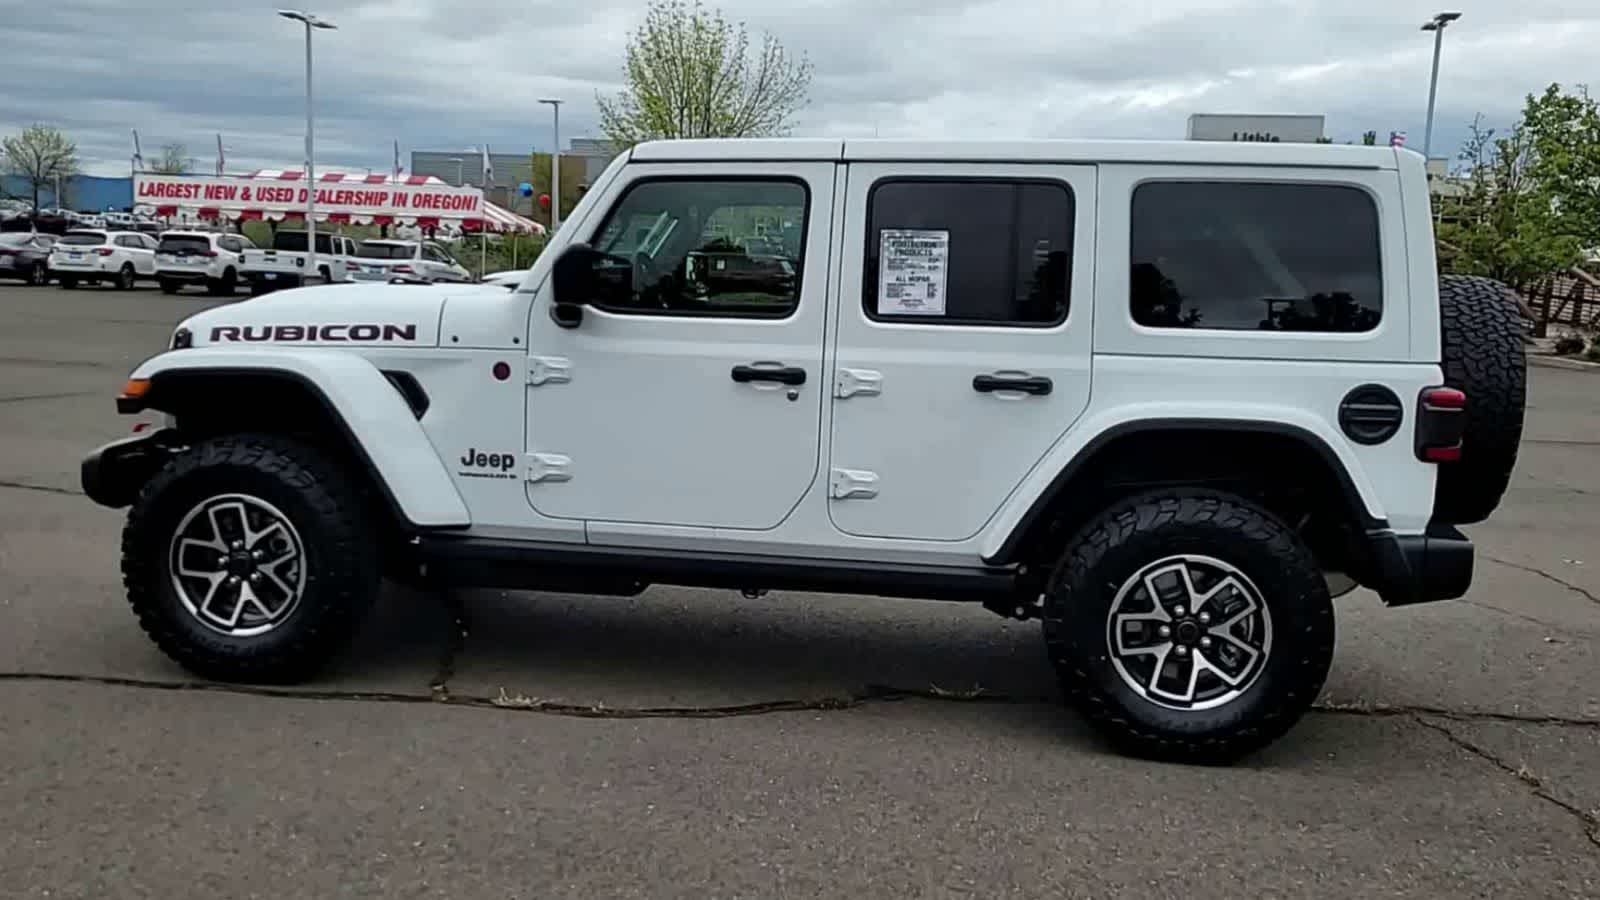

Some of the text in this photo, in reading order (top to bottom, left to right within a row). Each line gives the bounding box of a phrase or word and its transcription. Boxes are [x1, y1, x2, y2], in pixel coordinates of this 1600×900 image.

[138, 181, 478, 212] LARGEST NEW & USED DEALERSHIP IN OREGON!
[210, 324, 416, 342] RUBICON
[461, 447, 515, 472] Jeep
